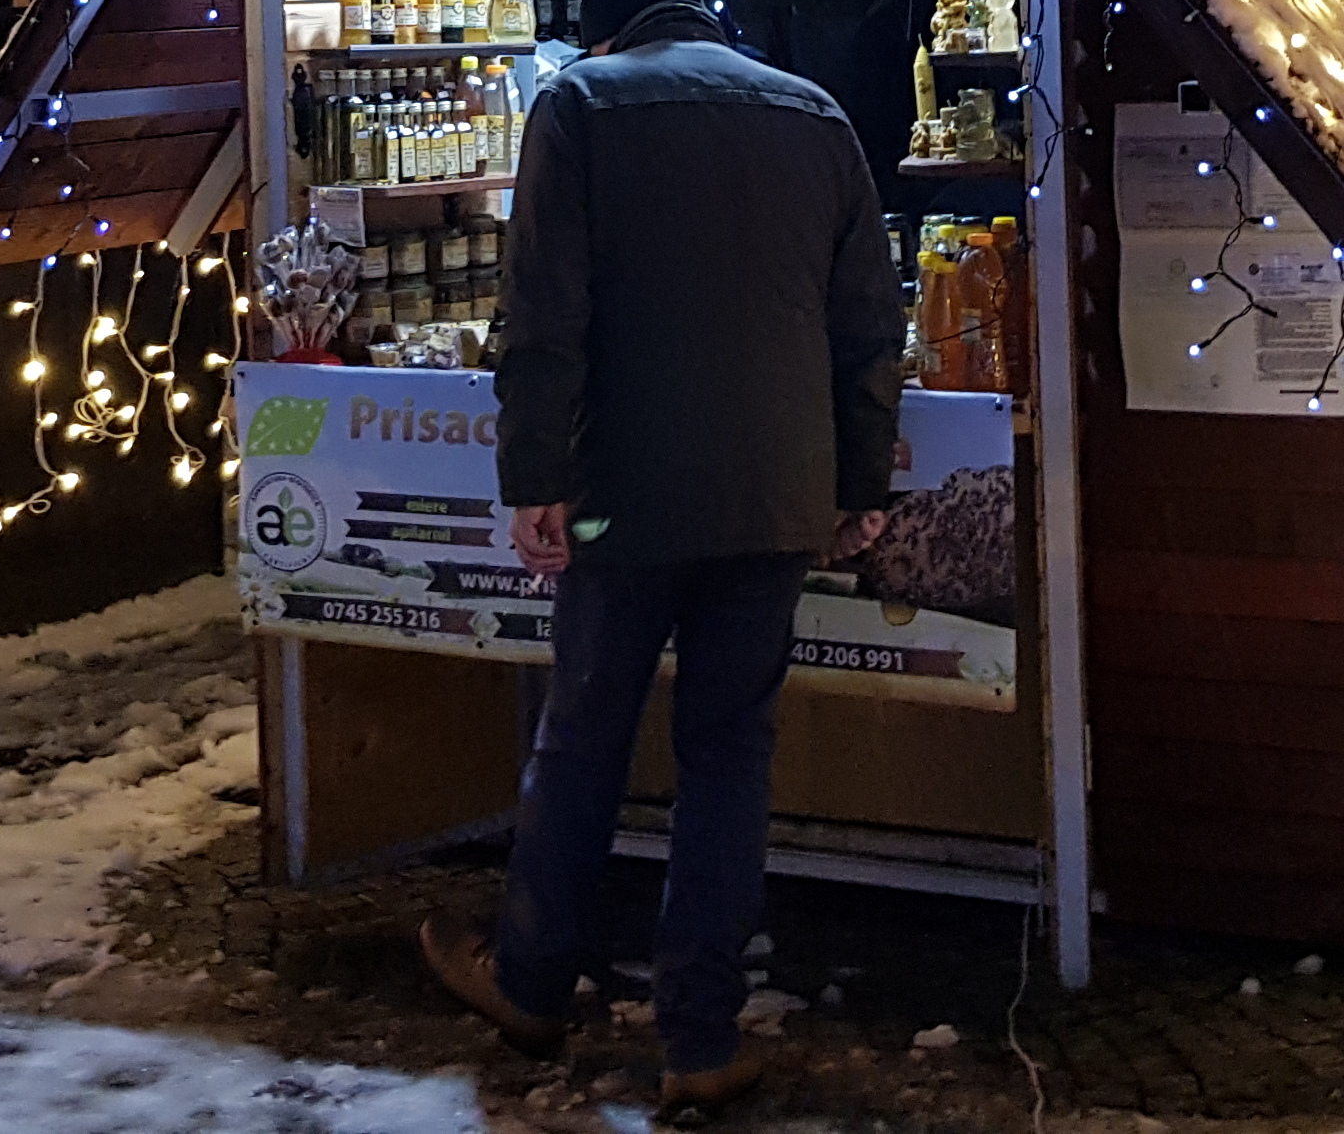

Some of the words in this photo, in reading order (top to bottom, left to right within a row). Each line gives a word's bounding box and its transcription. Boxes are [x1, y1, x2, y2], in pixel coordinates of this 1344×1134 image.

[349, 393, 497, 448] Prisac
[322, 601, 367, 623] 0745
[370, 604, 404, 626] 255
[406, 609, 441, 630] 216
[791, 642, 818, 663] 40
[821, 645, 862, 668] 206
[864, 649, 904, 671] 991
